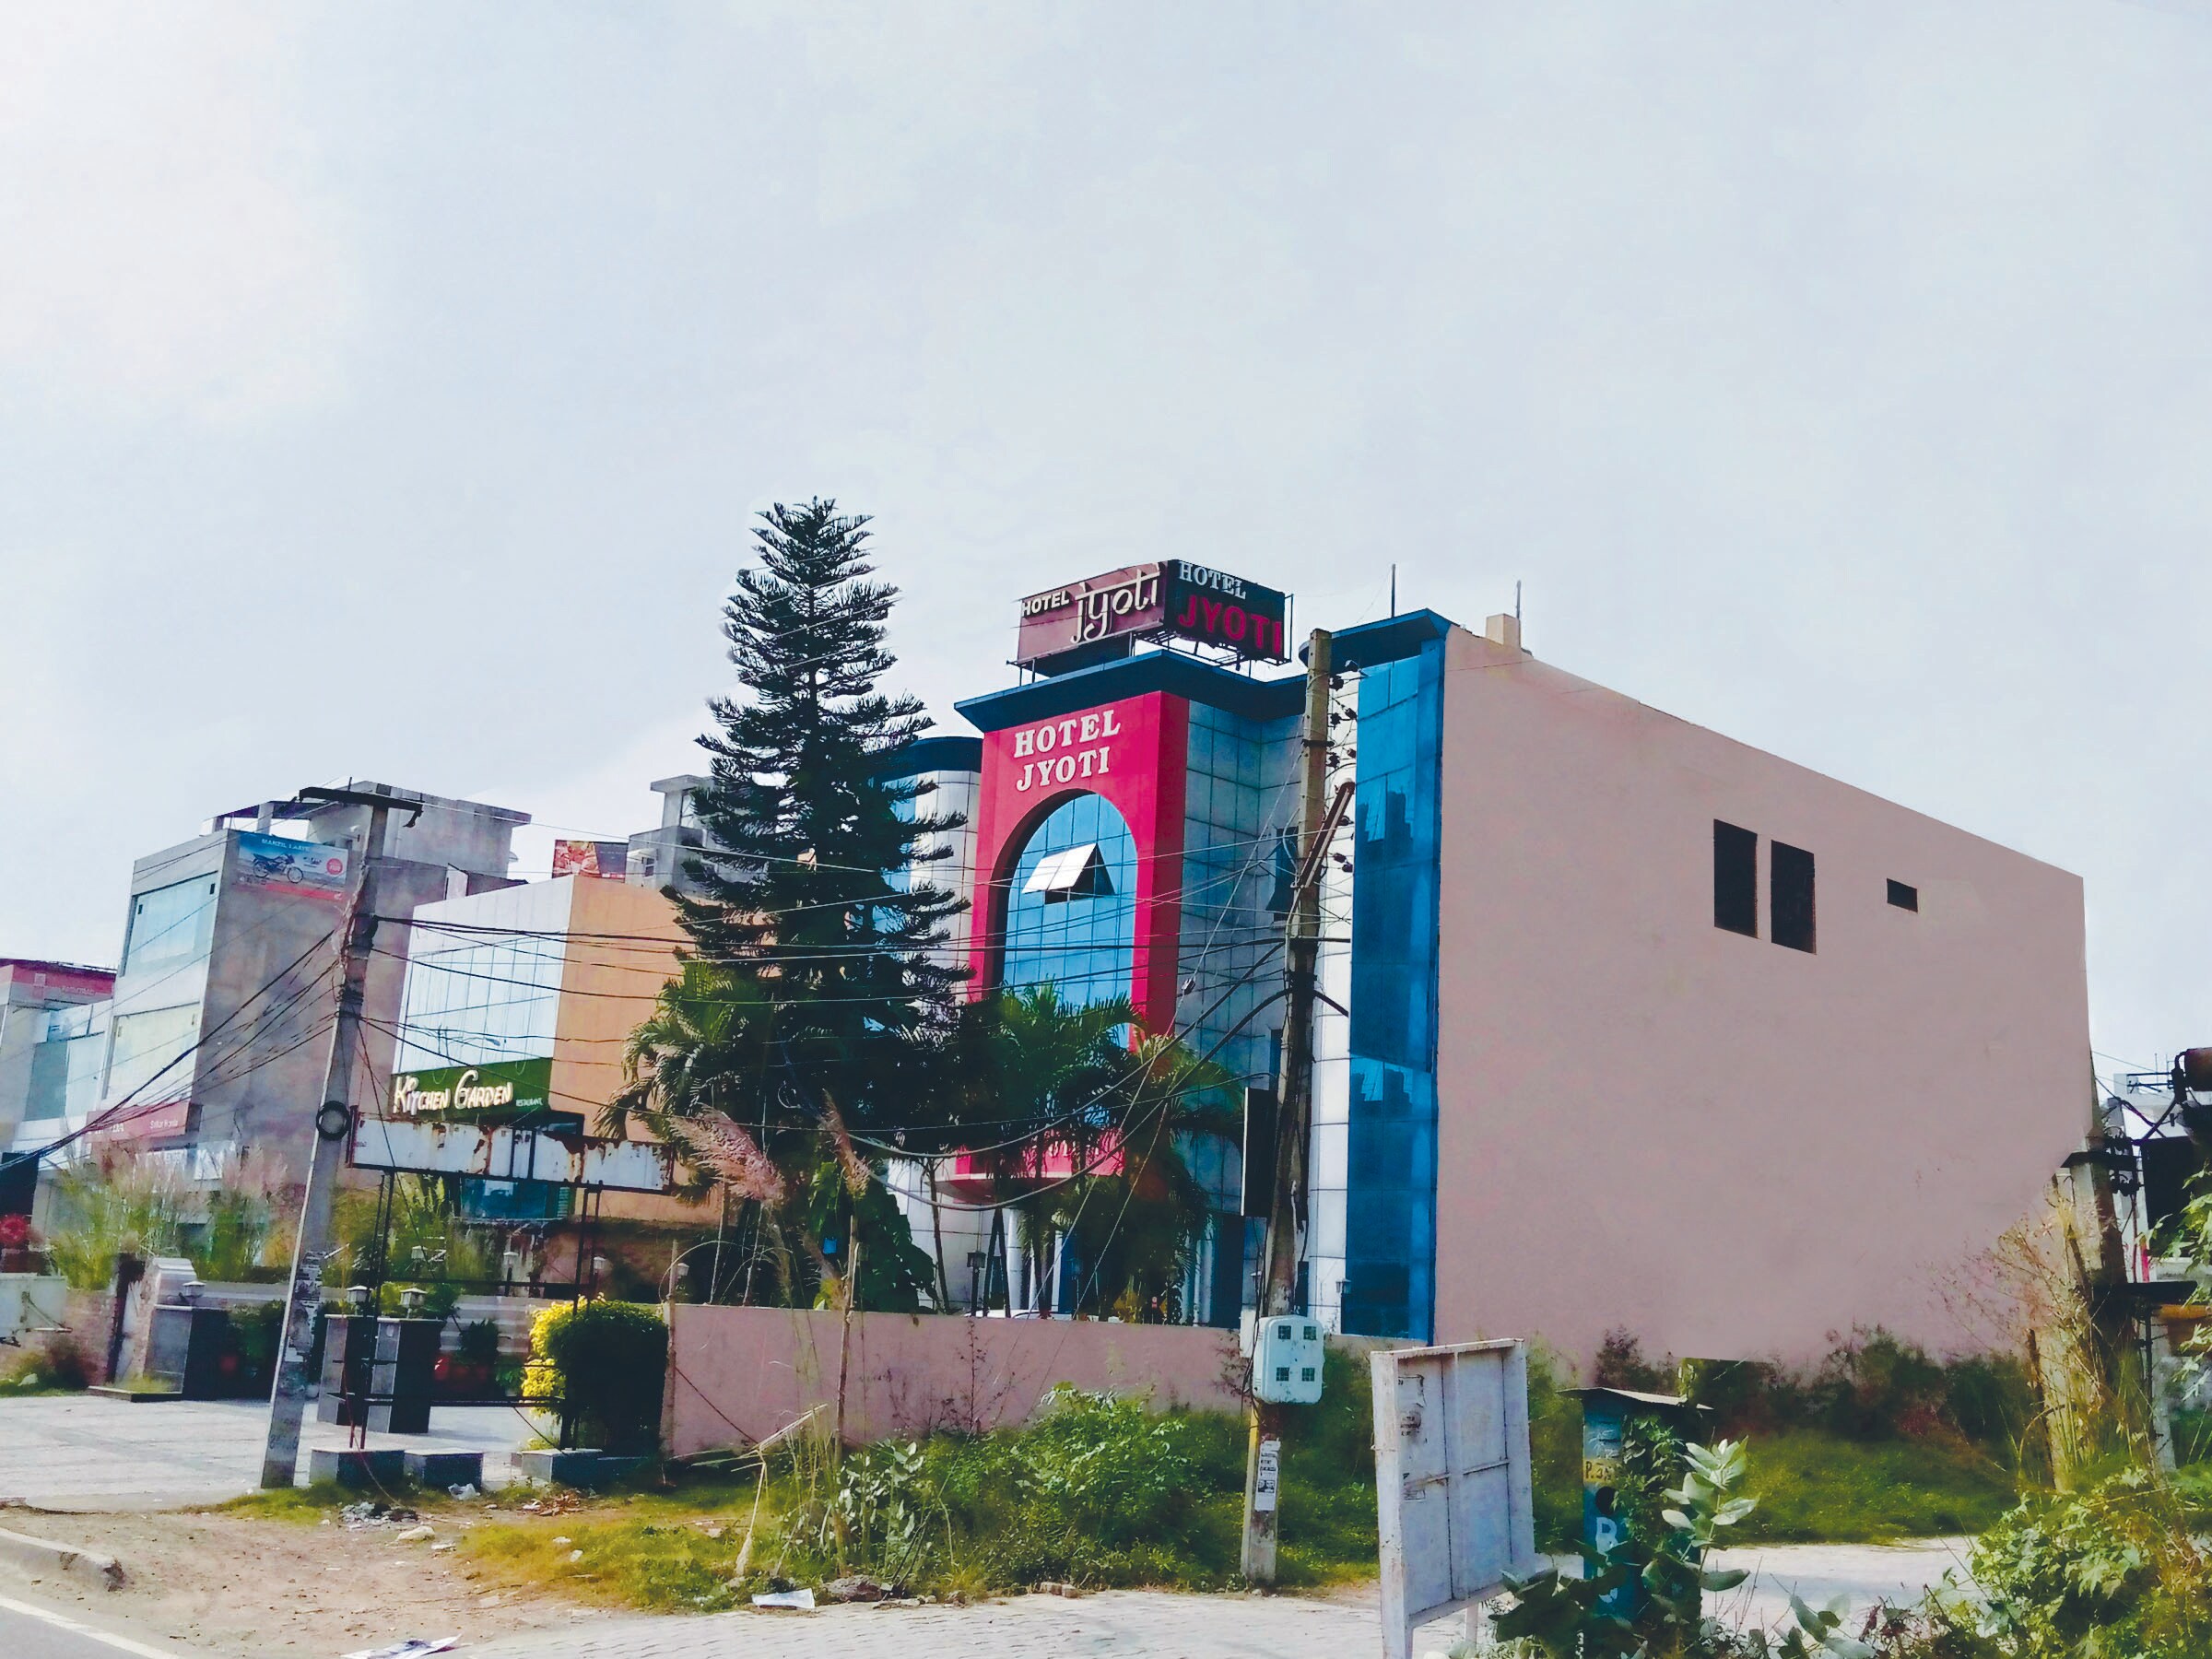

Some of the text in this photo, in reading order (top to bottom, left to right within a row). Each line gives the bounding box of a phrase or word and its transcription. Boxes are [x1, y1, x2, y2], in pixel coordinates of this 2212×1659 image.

[1179, 560, 1246, 599] HOTEL
[1021, 590, 1069, 618] HOTEL
[1178, 594, 1282, 653] JYOTI
[1014, 709, 1121, 758] HOTEL
[1016, 747, 1111, 792] JYOTI
